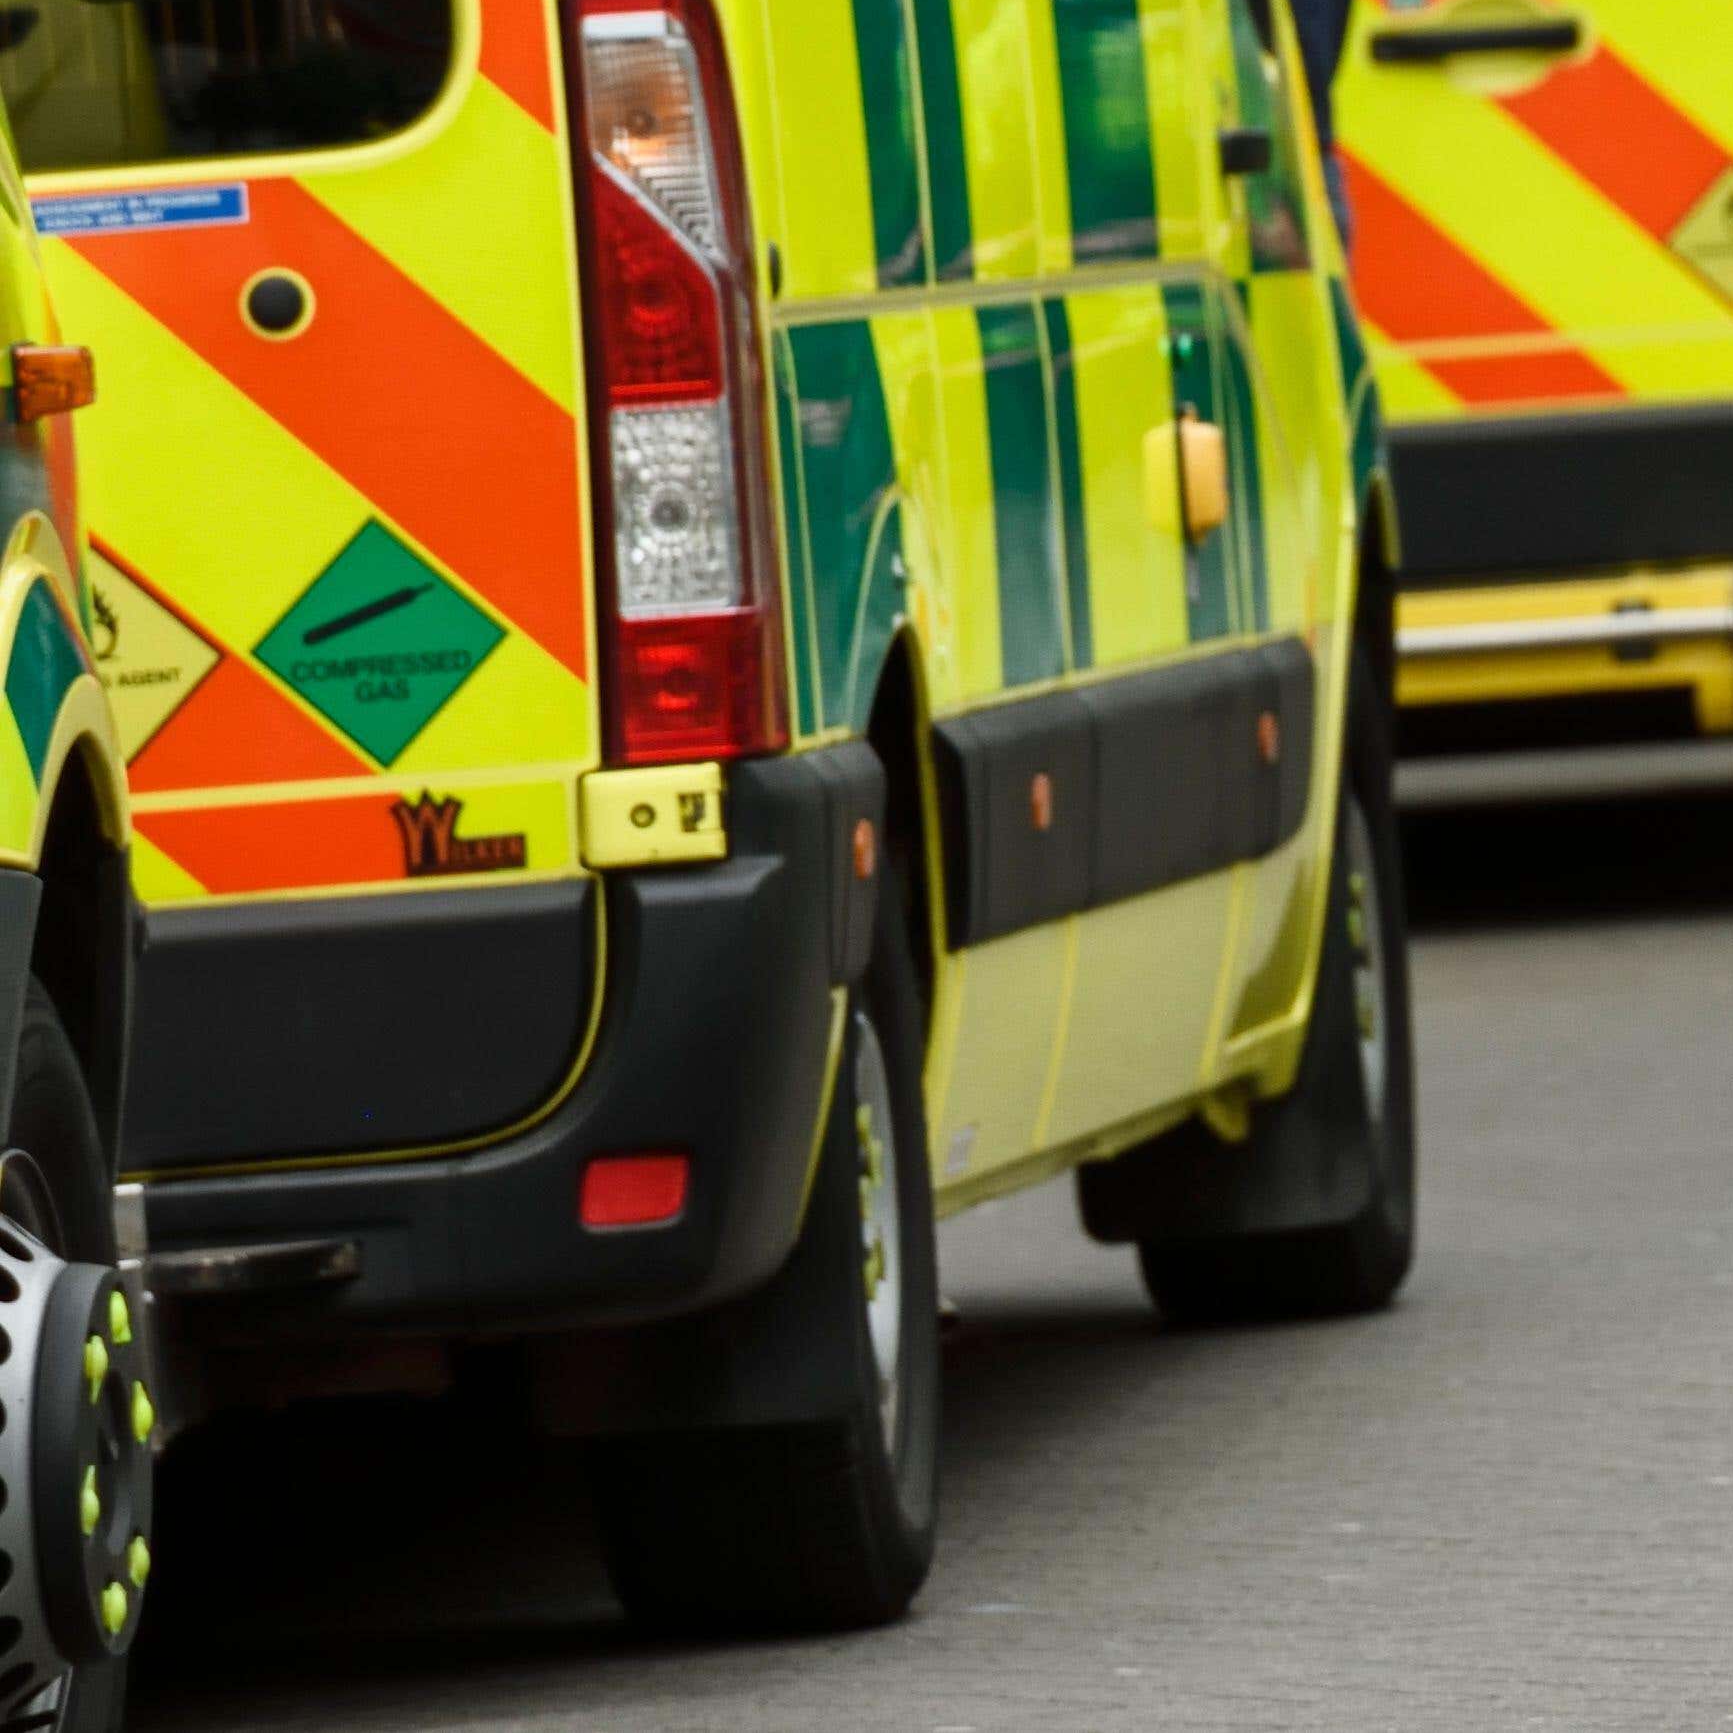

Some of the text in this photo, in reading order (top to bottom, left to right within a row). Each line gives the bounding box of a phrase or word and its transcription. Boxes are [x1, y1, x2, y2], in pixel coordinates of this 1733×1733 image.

[117, 667, 182, 688] AGENT
[289, 649, 472, 683] COMPRESSED
[354, 680, 411, 704] GAS
